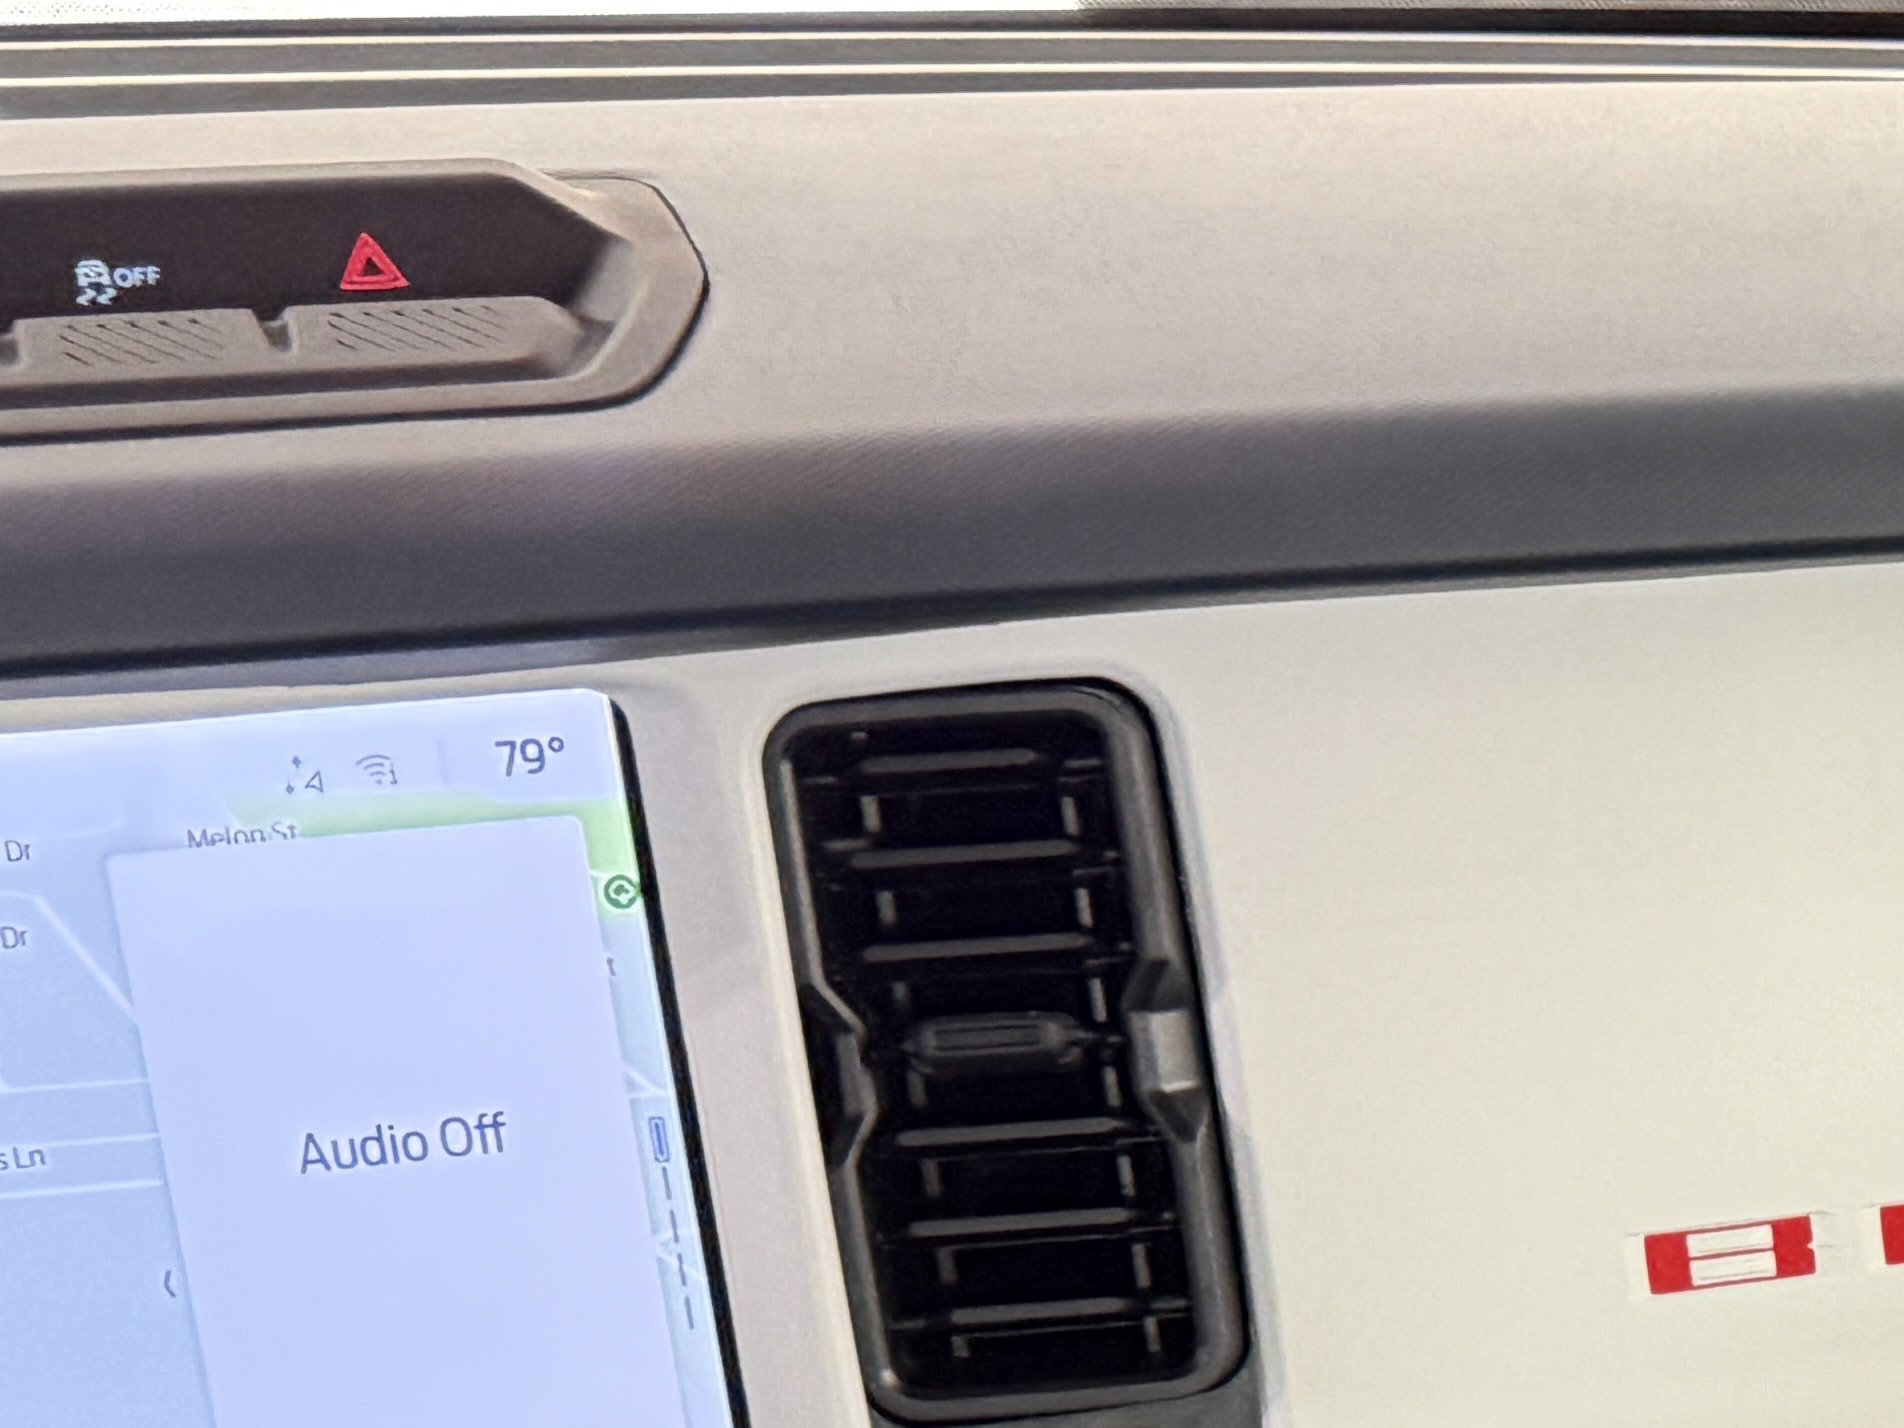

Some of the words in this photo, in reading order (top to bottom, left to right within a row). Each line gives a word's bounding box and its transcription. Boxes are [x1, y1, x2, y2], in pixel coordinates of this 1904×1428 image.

[113, 265, 161, 288] OFF
[494, 736, 565, 777] 79°
[4, 840, 31, 862] Dr
[0, 926, 28, 950] Dr
[300, 1124, 429, 1175] Audio
[440, 1110, 507, 1158] Off
[14, 1147, 47, 1169] Ln
